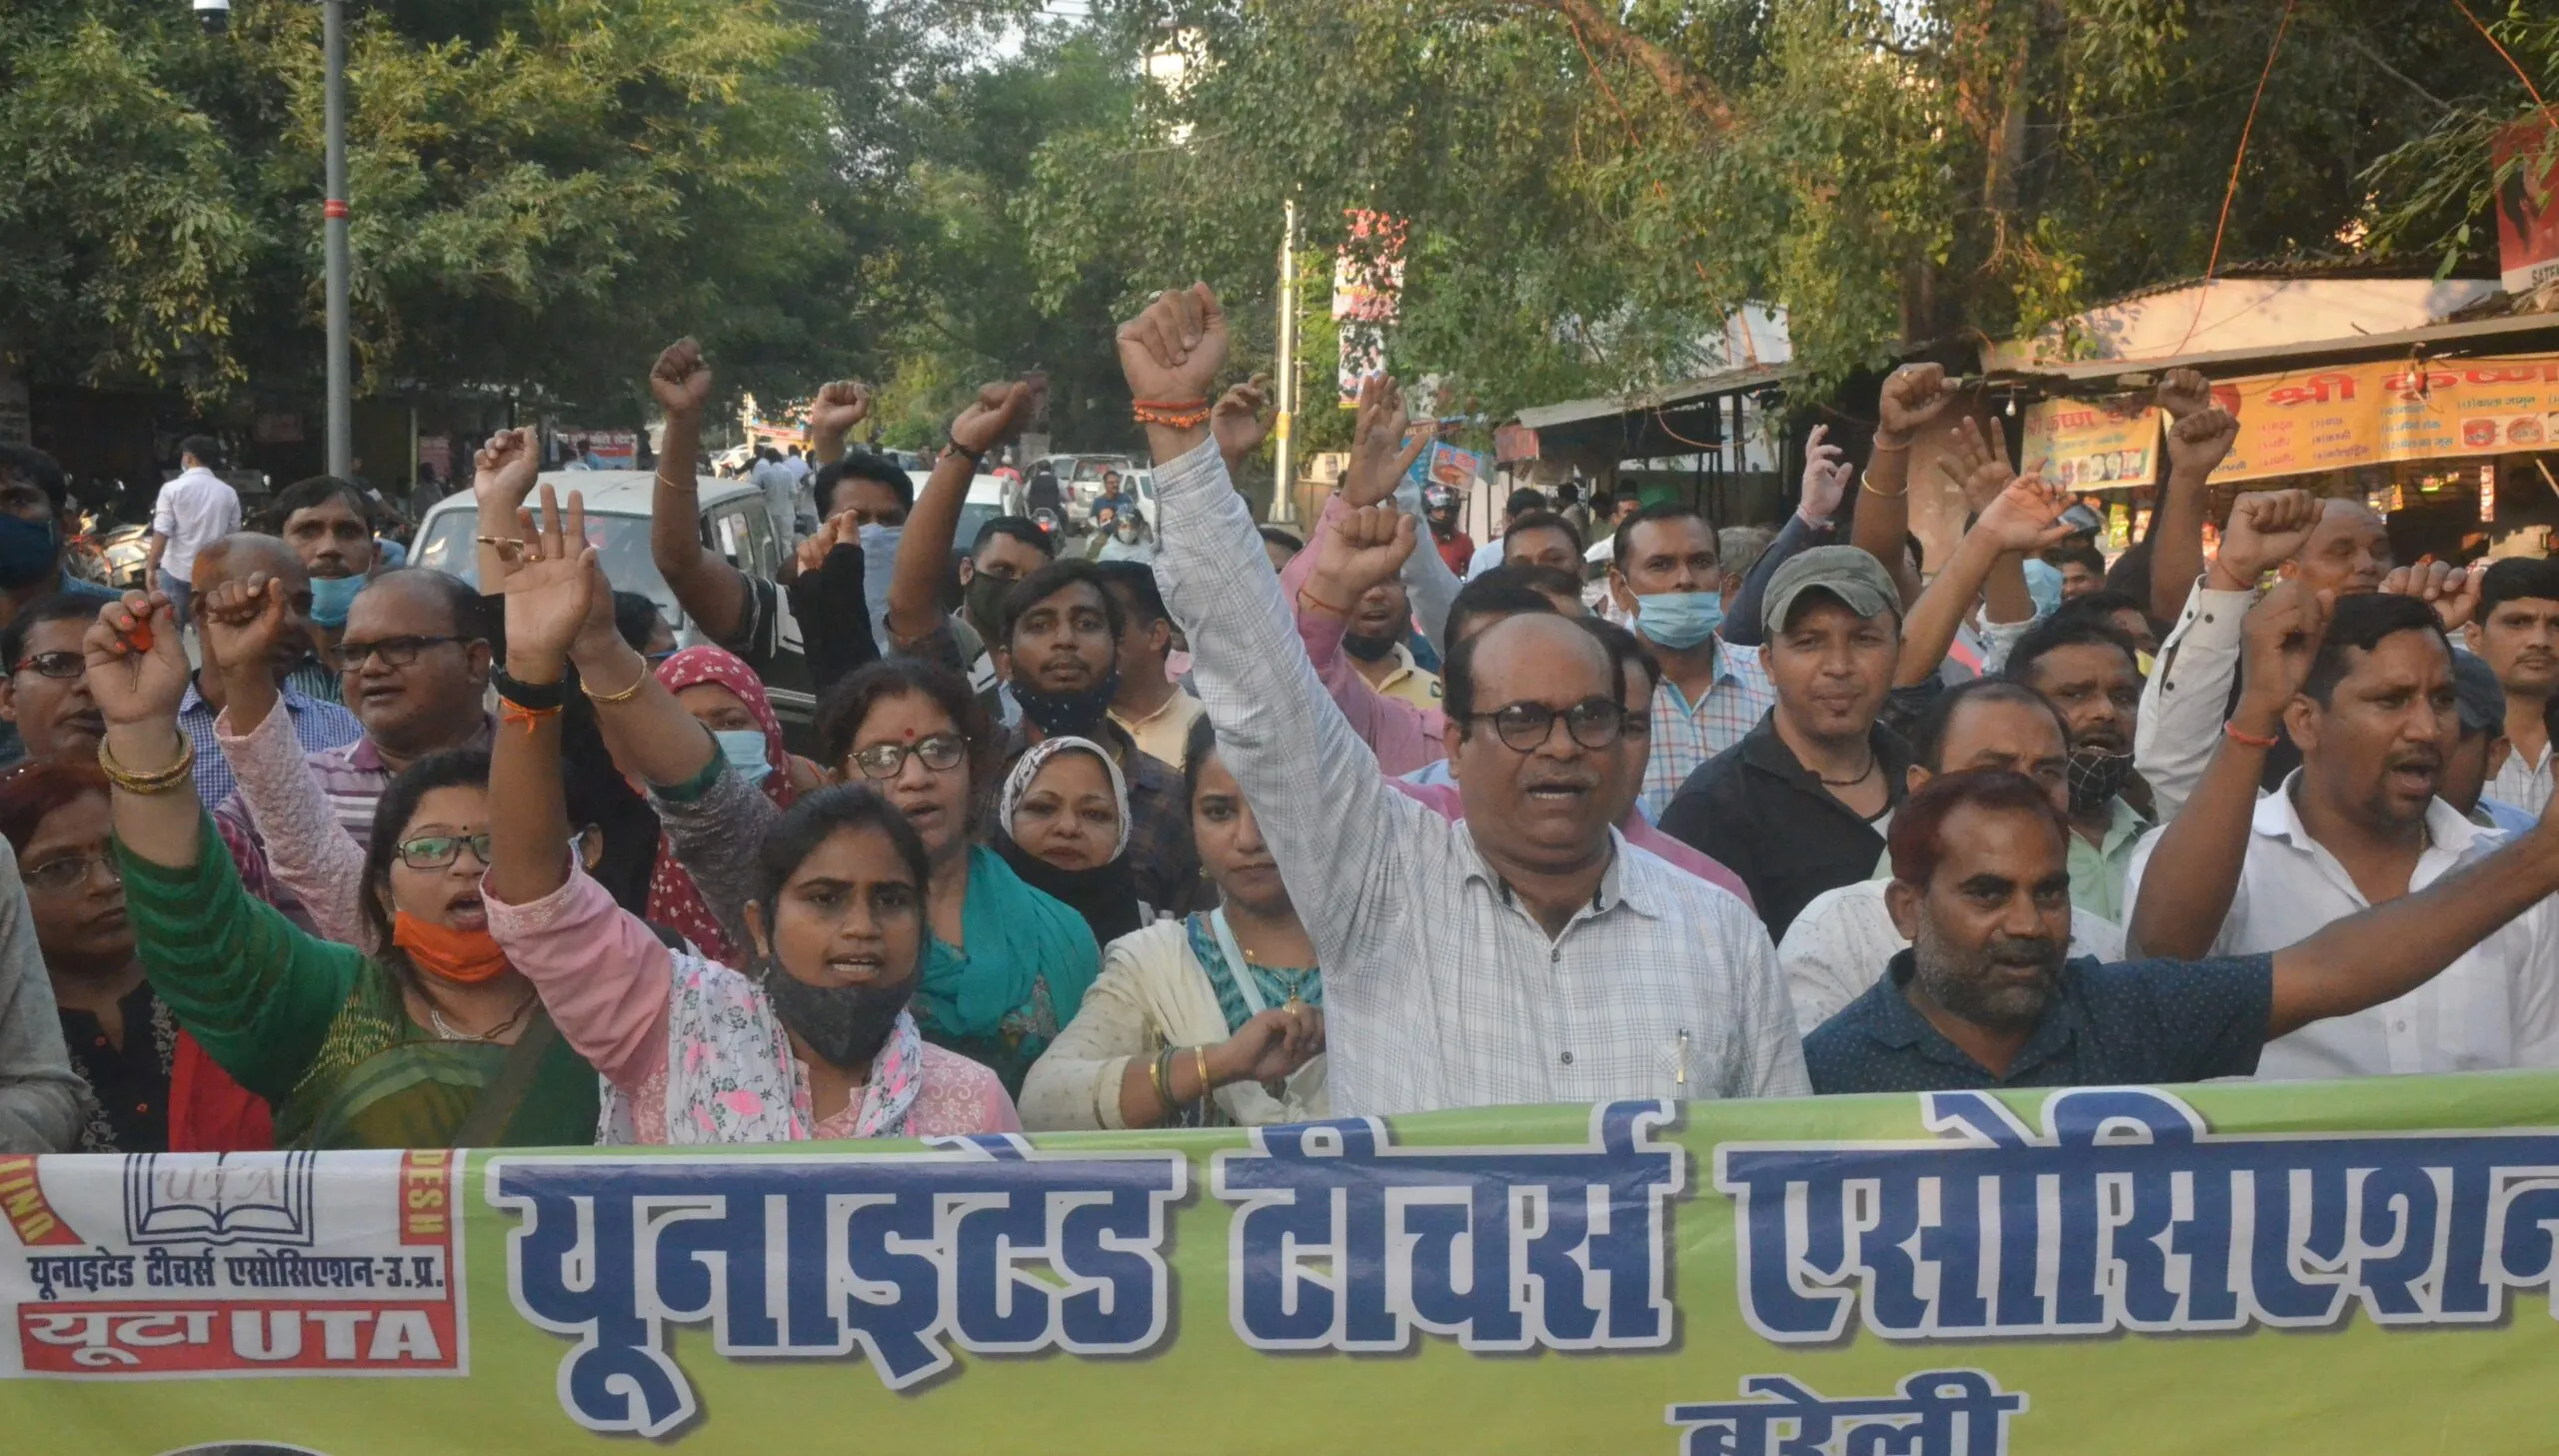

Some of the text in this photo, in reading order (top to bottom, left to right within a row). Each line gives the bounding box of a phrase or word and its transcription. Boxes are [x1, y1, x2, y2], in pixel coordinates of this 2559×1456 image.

[2265, 372, 2360, 408] श्री
[156, 1163, 280, 1201] UTA
[27, 1246, 135, 1300] यूनाइटेड
[144, 1247, 216, 1287] टीचर्स
[500, 1133, 1174, 1426] यूनाइटेड
[1225, 1100, 1674, 1341] टीचर्स
[24, 1309, 443, 1367] यूटा UTA
